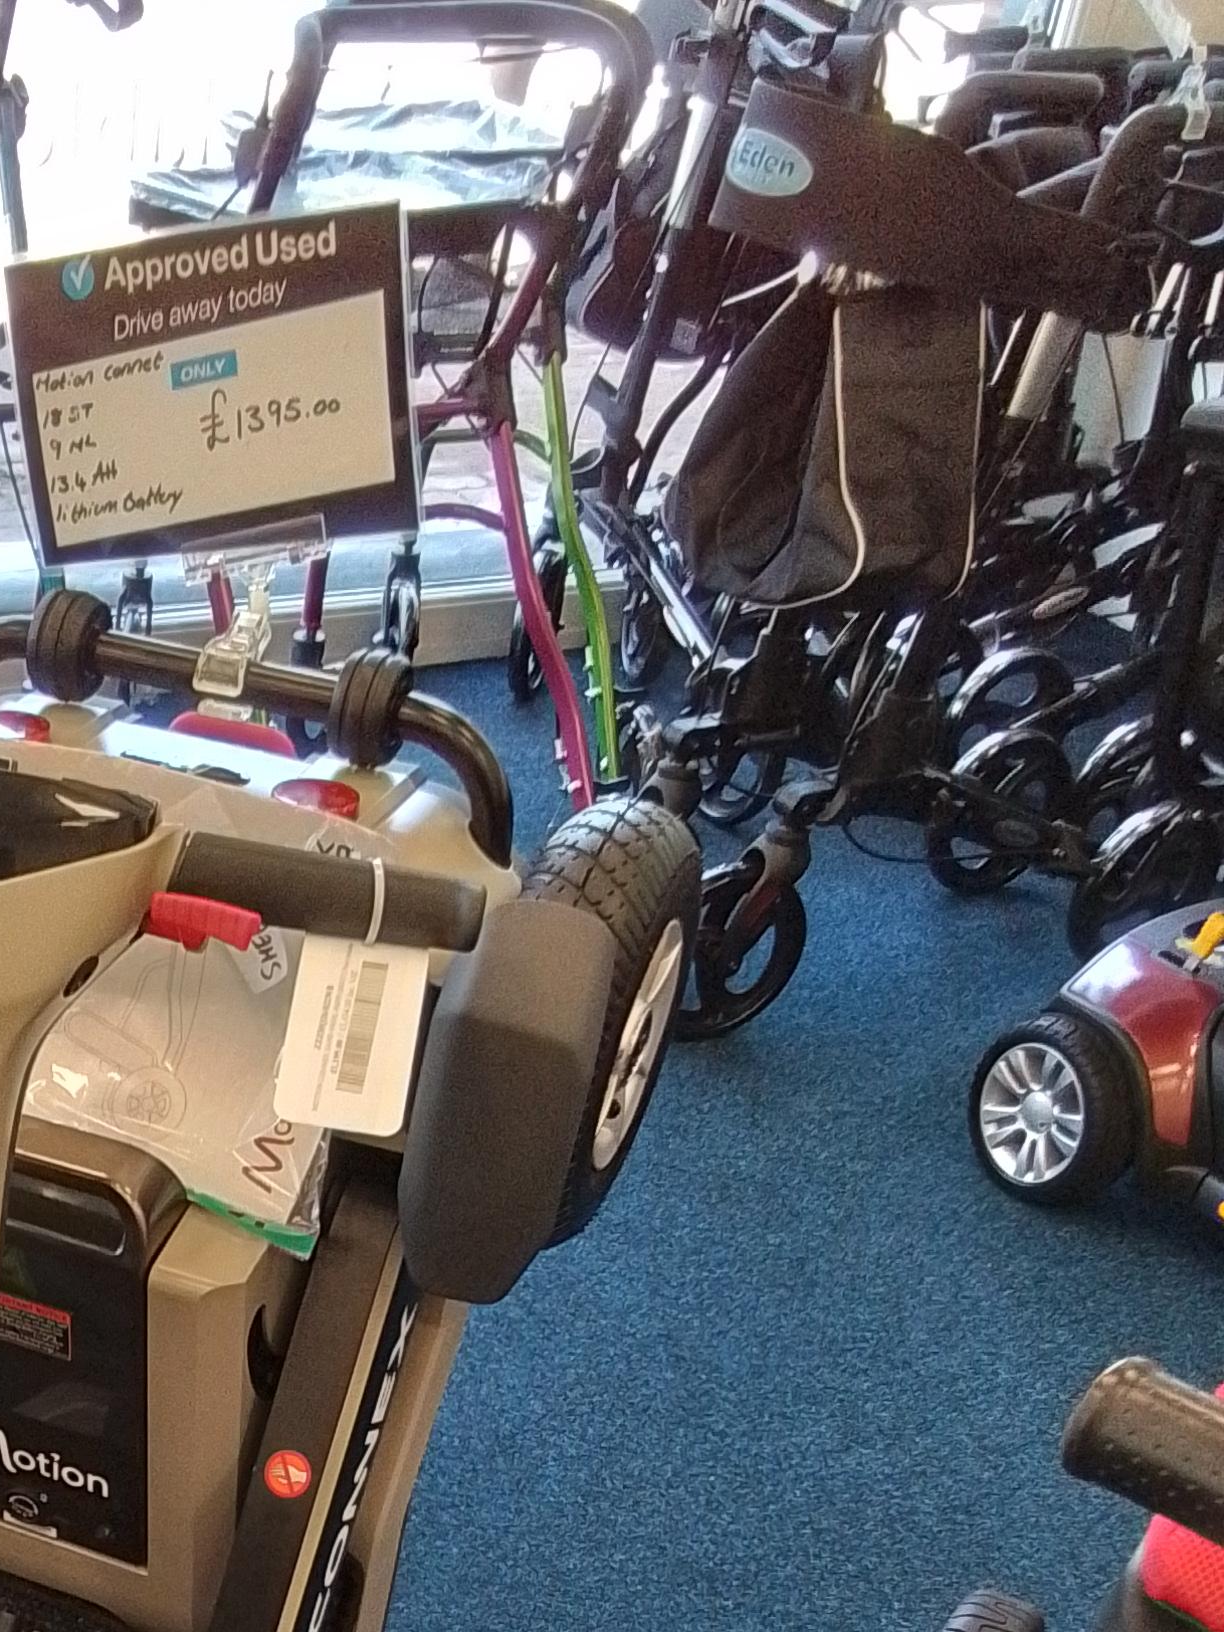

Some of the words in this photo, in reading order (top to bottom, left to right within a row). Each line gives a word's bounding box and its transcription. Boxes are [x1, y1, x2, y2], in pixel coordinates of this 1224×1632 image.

[738, 140, 795, 178] Eden
[104, 233, 249, 295] Approved
[255, 218, 337, 266] Used
[113, 308, 164, 342] Drive
[169, 294, 223, 324] away
[228, 277, 288, 314] today
[35, 370, 95, 393] Motion
[180, 357, 226, 382] ONLY
[42, 407, 63, 430] 18
[199, 387, 341, 452] £1395.00
[49, 438, 63, 461] 9
[252, 924, 282, 981] SHE
